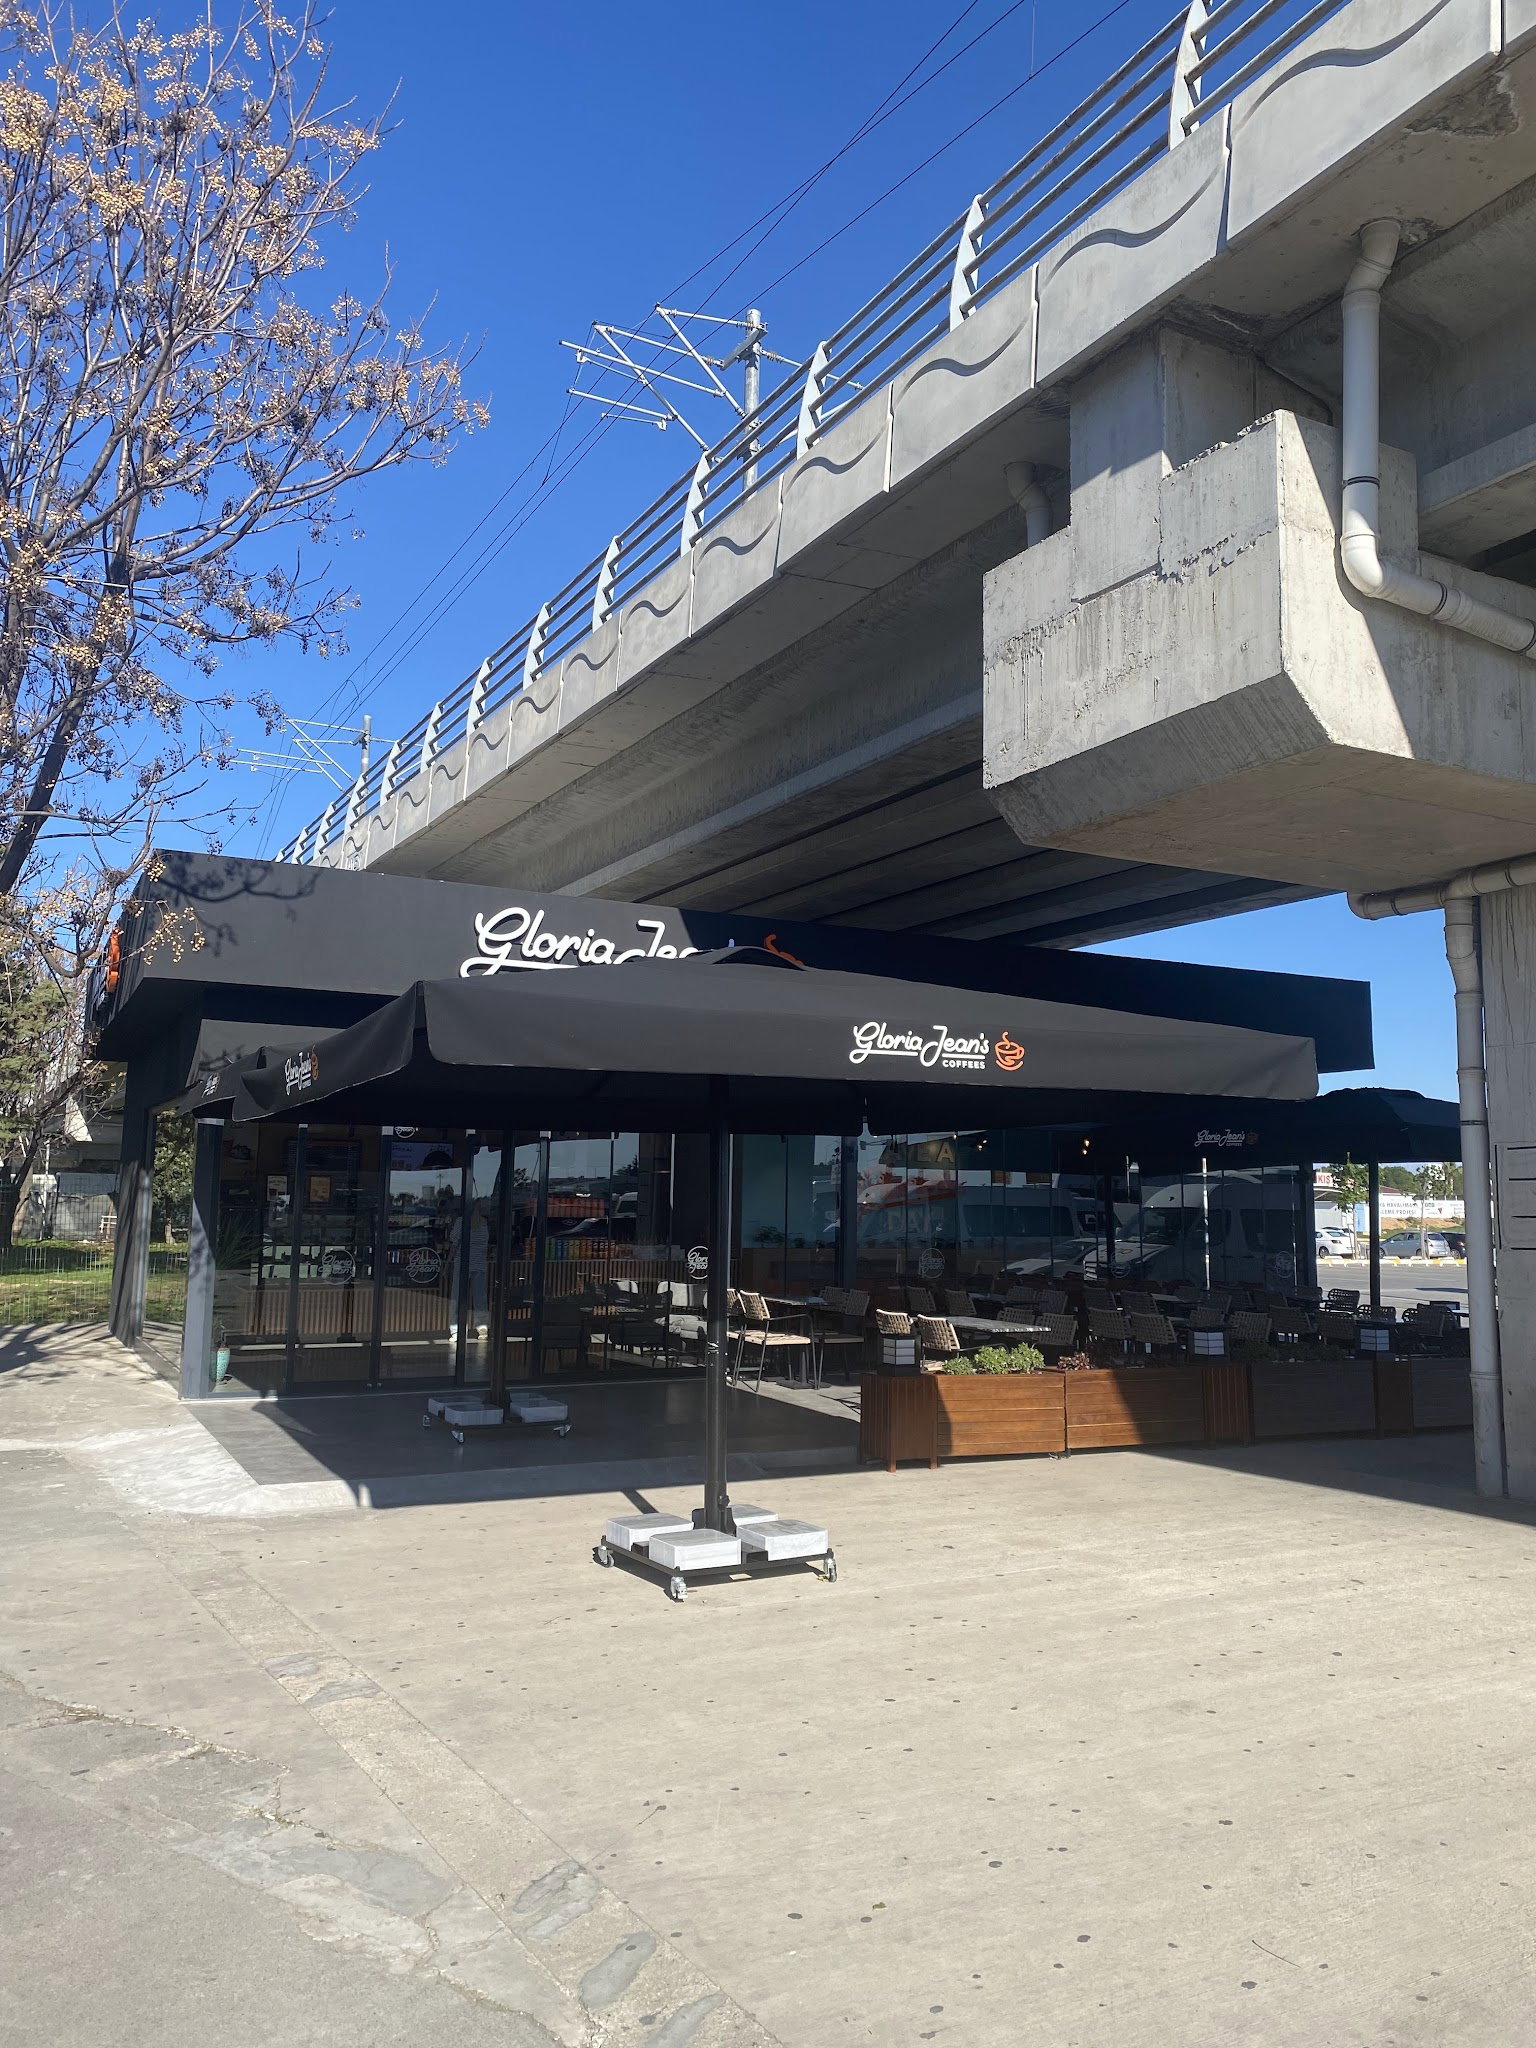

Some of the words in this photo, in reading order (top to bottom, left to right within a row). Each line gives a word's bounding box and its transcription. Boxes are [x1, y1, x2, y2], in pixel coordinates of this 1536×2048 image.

[459, 907, 614, 978] Gloria
[849, 1021, 922, 1064] Gloria
[919, 1024, 990, 1067] Jean's
[942, 1059, 986, 1070] COFFEES
